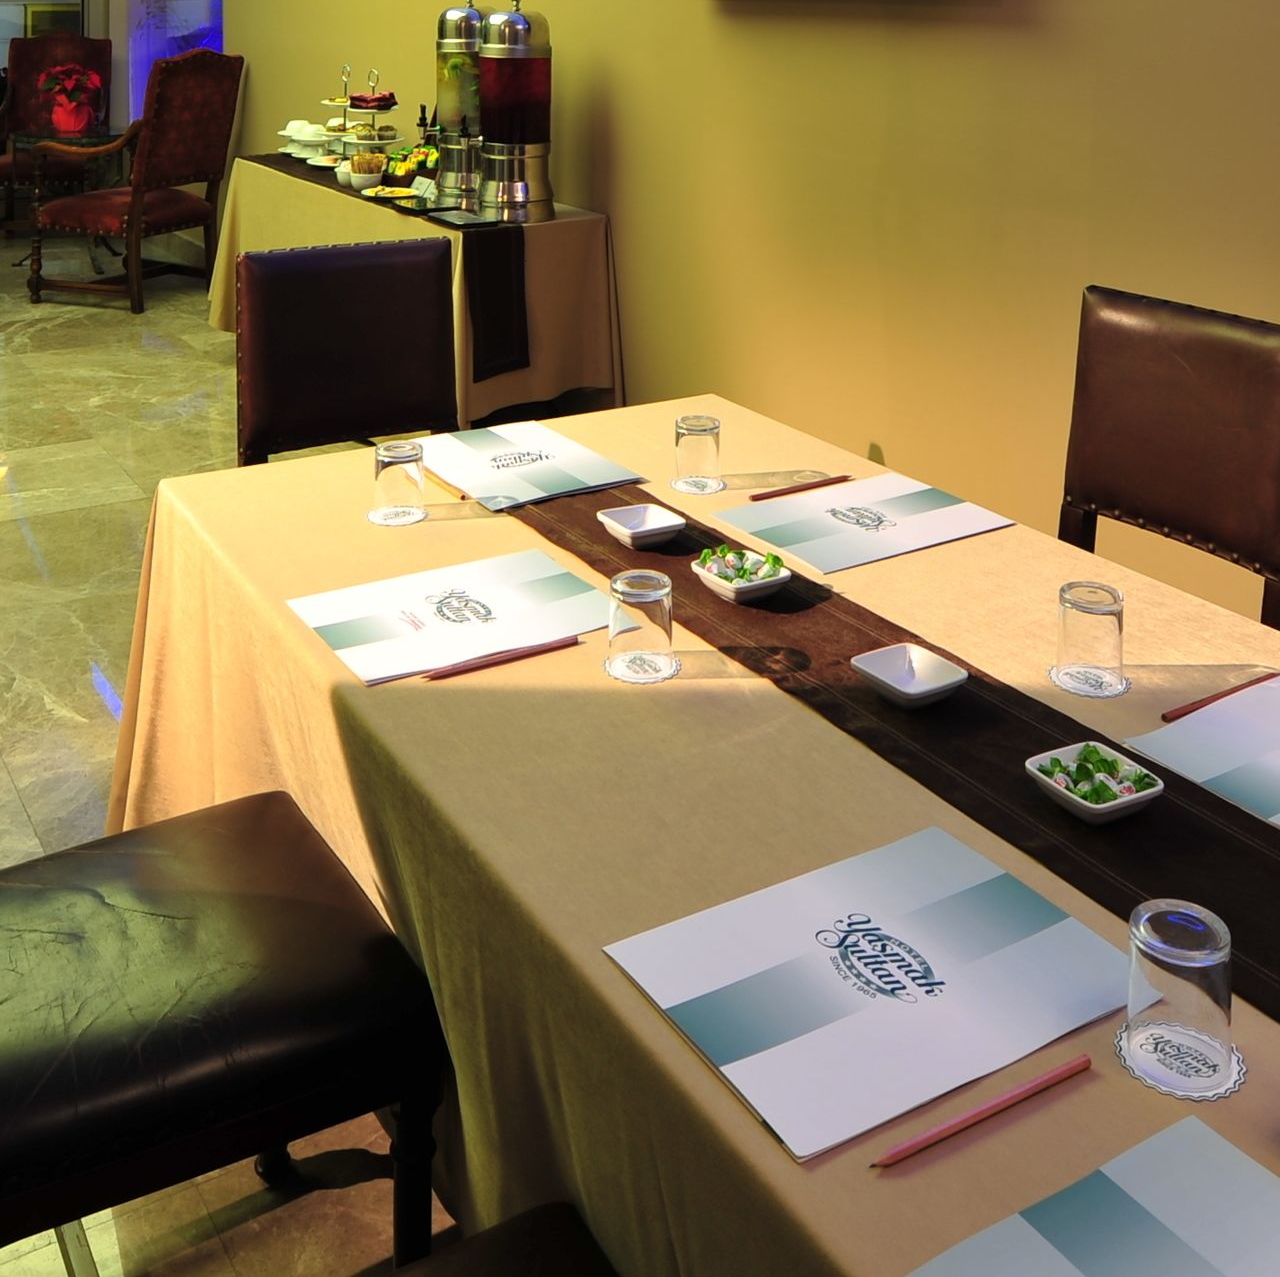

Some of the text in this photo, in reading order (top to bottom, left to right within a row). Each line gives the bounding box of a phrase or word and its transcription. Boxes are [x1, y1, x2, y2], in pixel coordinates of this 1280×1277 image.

[815, 929, 918, 1003] Sultan
[830, 955, 877, 999] SINCE 1965
[833, 913, 946, 997] Yasmak
